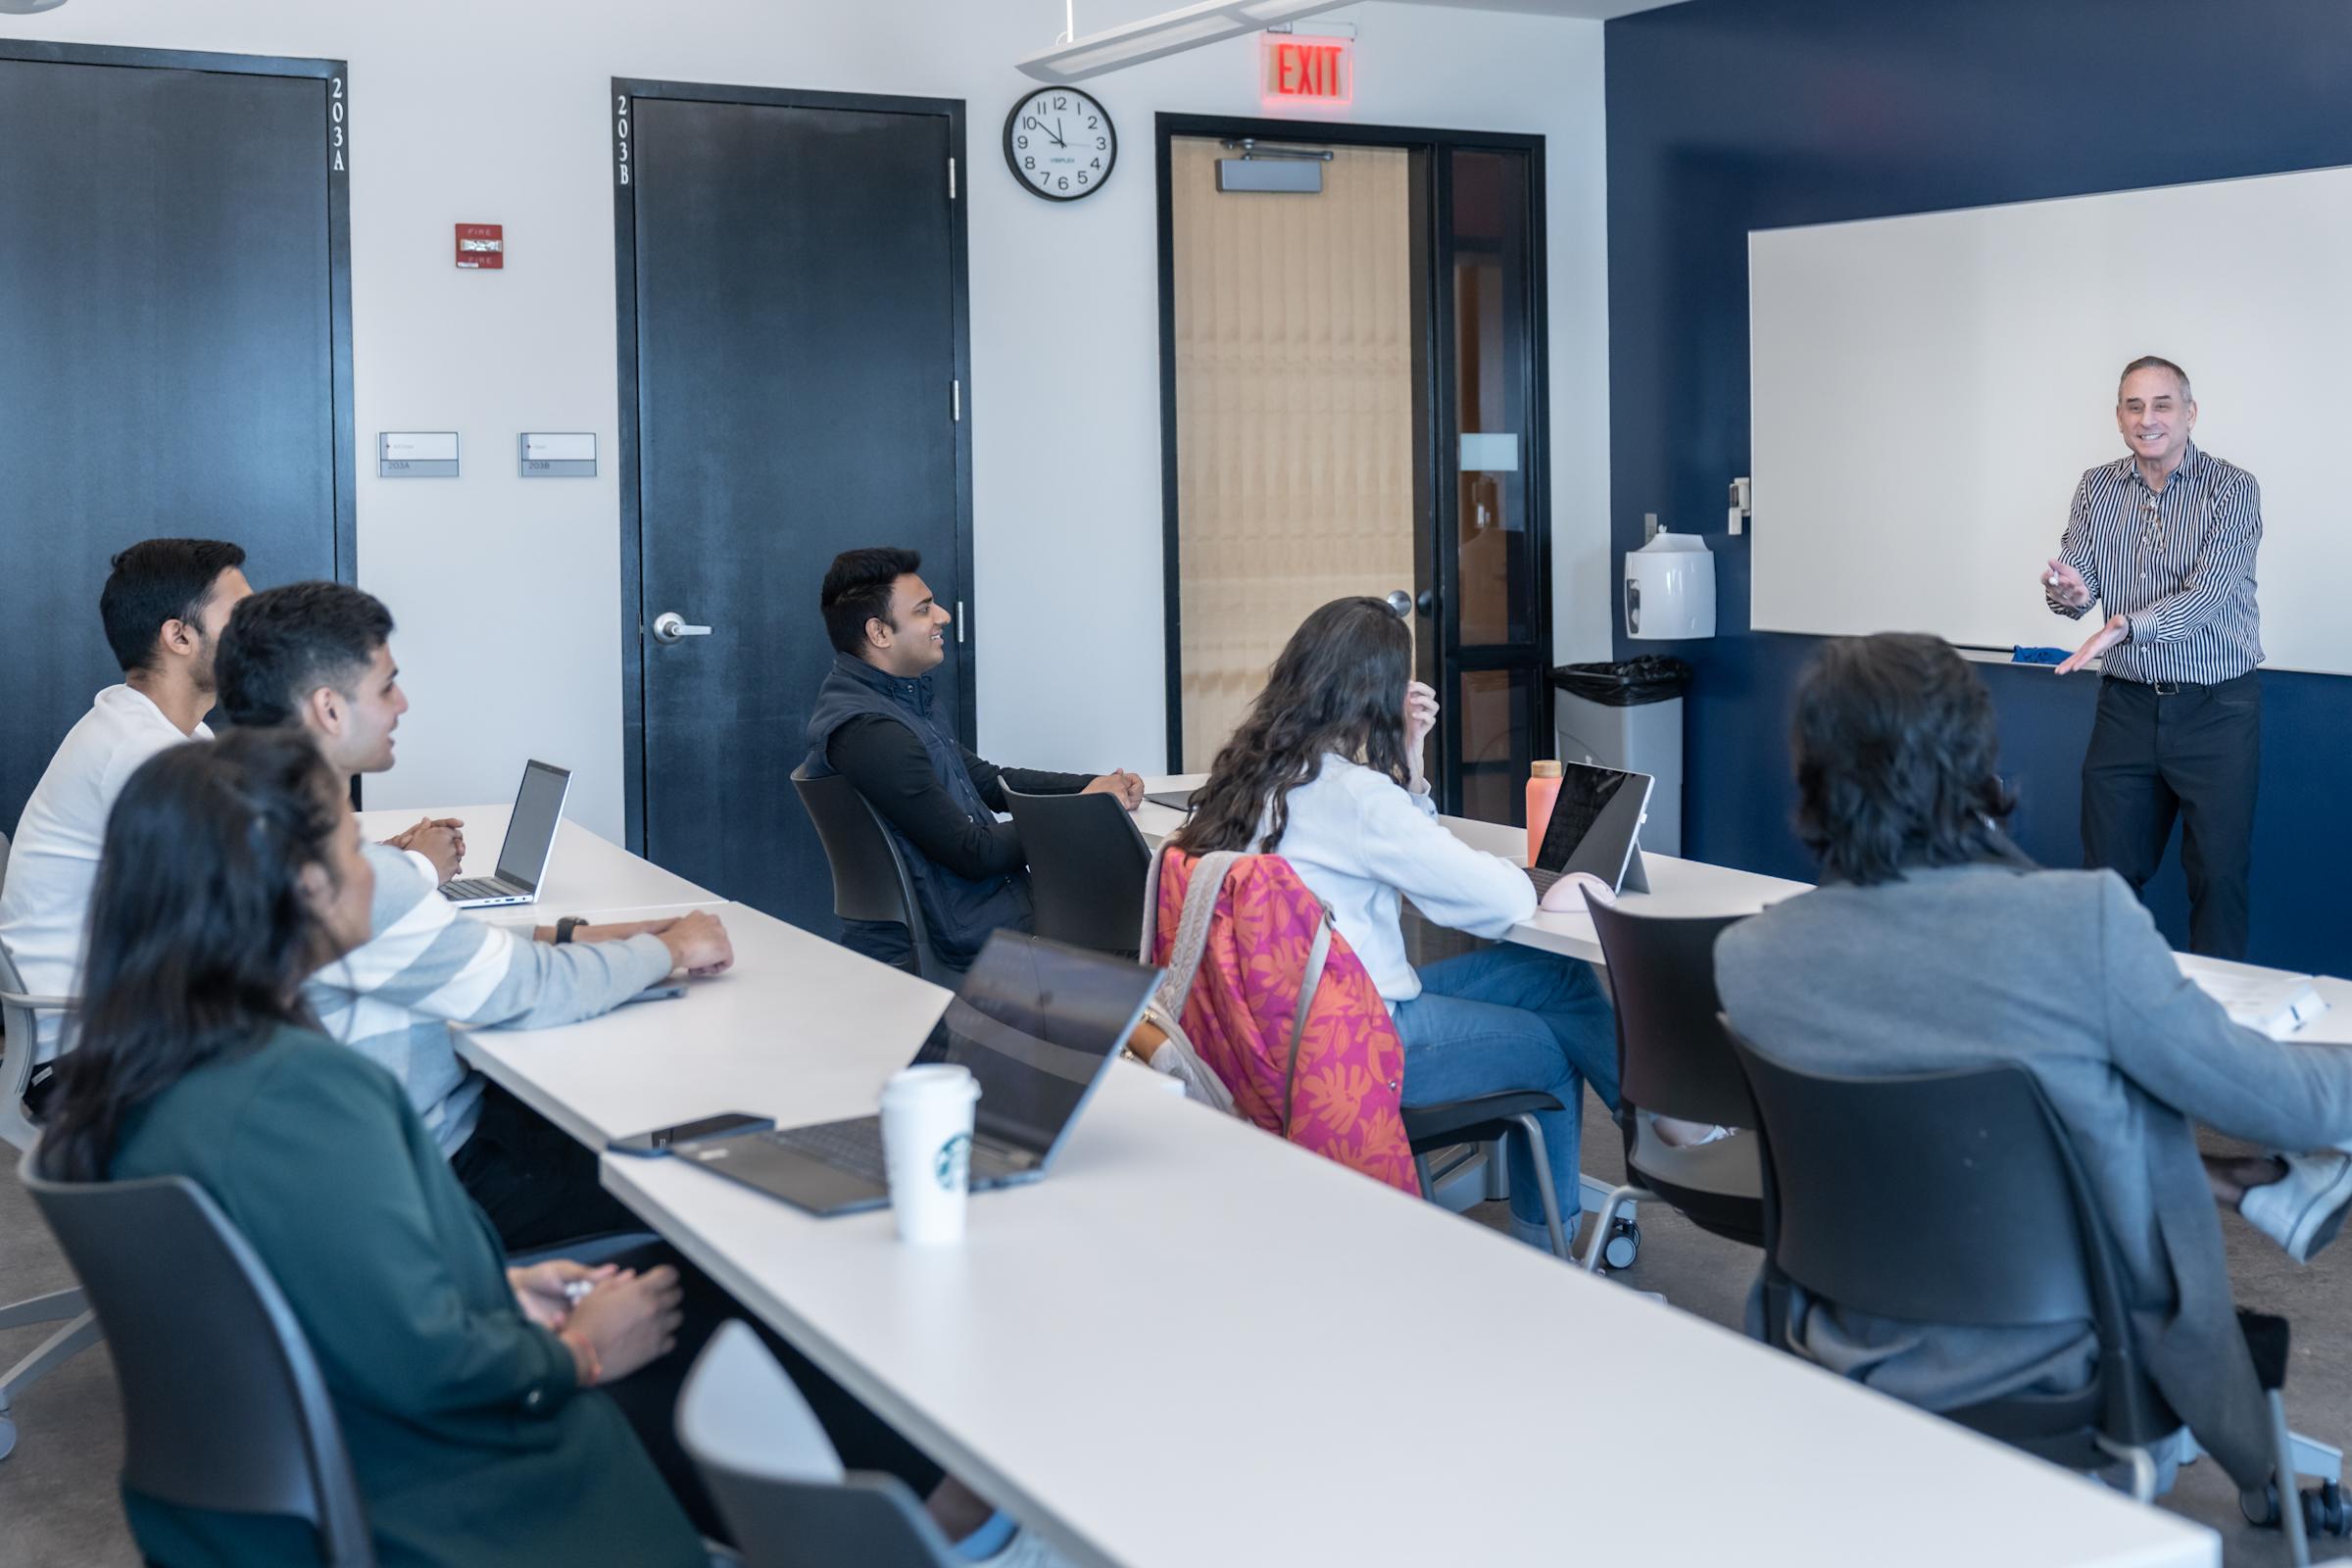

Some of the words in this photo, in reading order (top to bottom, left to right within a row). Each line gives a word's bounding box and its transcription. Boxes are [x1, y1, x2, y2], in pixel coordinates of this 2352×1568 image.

[1278, 44, 1342, 96] EXIT
[1037, 101, 1047, 115] 11
[1054, 97, 1067, 110] 12
[332, 77, 345, 171] 203A
[1023, 116, 1037, 129] 10
[1088, 116, 1098, 129] 2
[617, 95, 629, 184] 203B
[1017, 135, 1028, 149] 9
[1096, 136, 1106, 150] 3
[1025, 156, 1036, 170] 8
[1090, 157, 1101, 171] 4
[1041, 172, 1051, 185] 7
[1058, 176, 1069, 190] 6
[1077, 171, 1088, 184] 5
